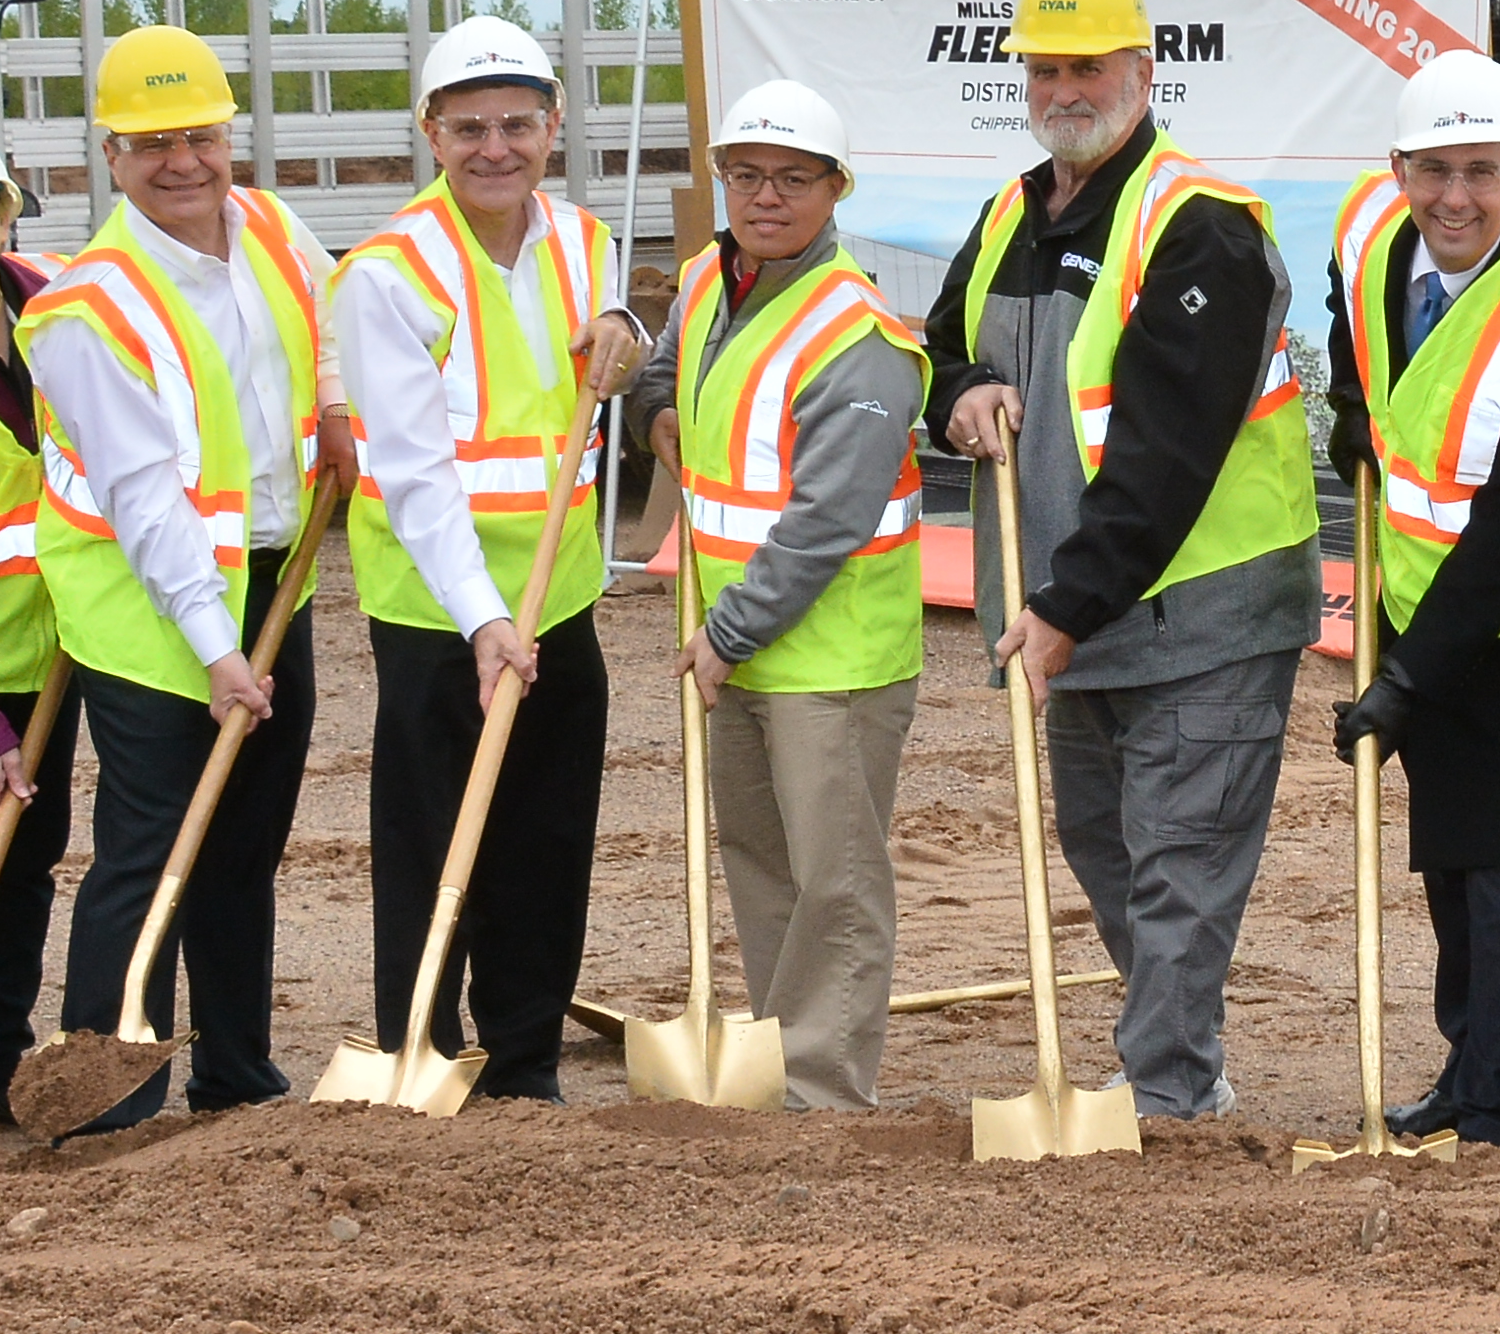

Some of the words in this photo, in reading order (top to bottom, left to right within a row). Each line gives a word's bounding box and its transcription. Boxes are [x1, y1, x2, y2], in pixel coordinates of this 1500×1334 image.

[957, 2, 1013, 19] MILLS
[1039, 0, 1077, 11] RYAN
[1154, 23, 1225, 63] RM
[1396, 27, 1437, 69] 20
[145, 72, 188, 87] RYAN
[961, 82, 1028, 103] DISTRI
[1151, 82, 1187, 103] TER
[771, 124, 795, 133] FARM
[971, 117, 1030, 130] CHIPPEW
[1156, 118, 1171, 131] IN
